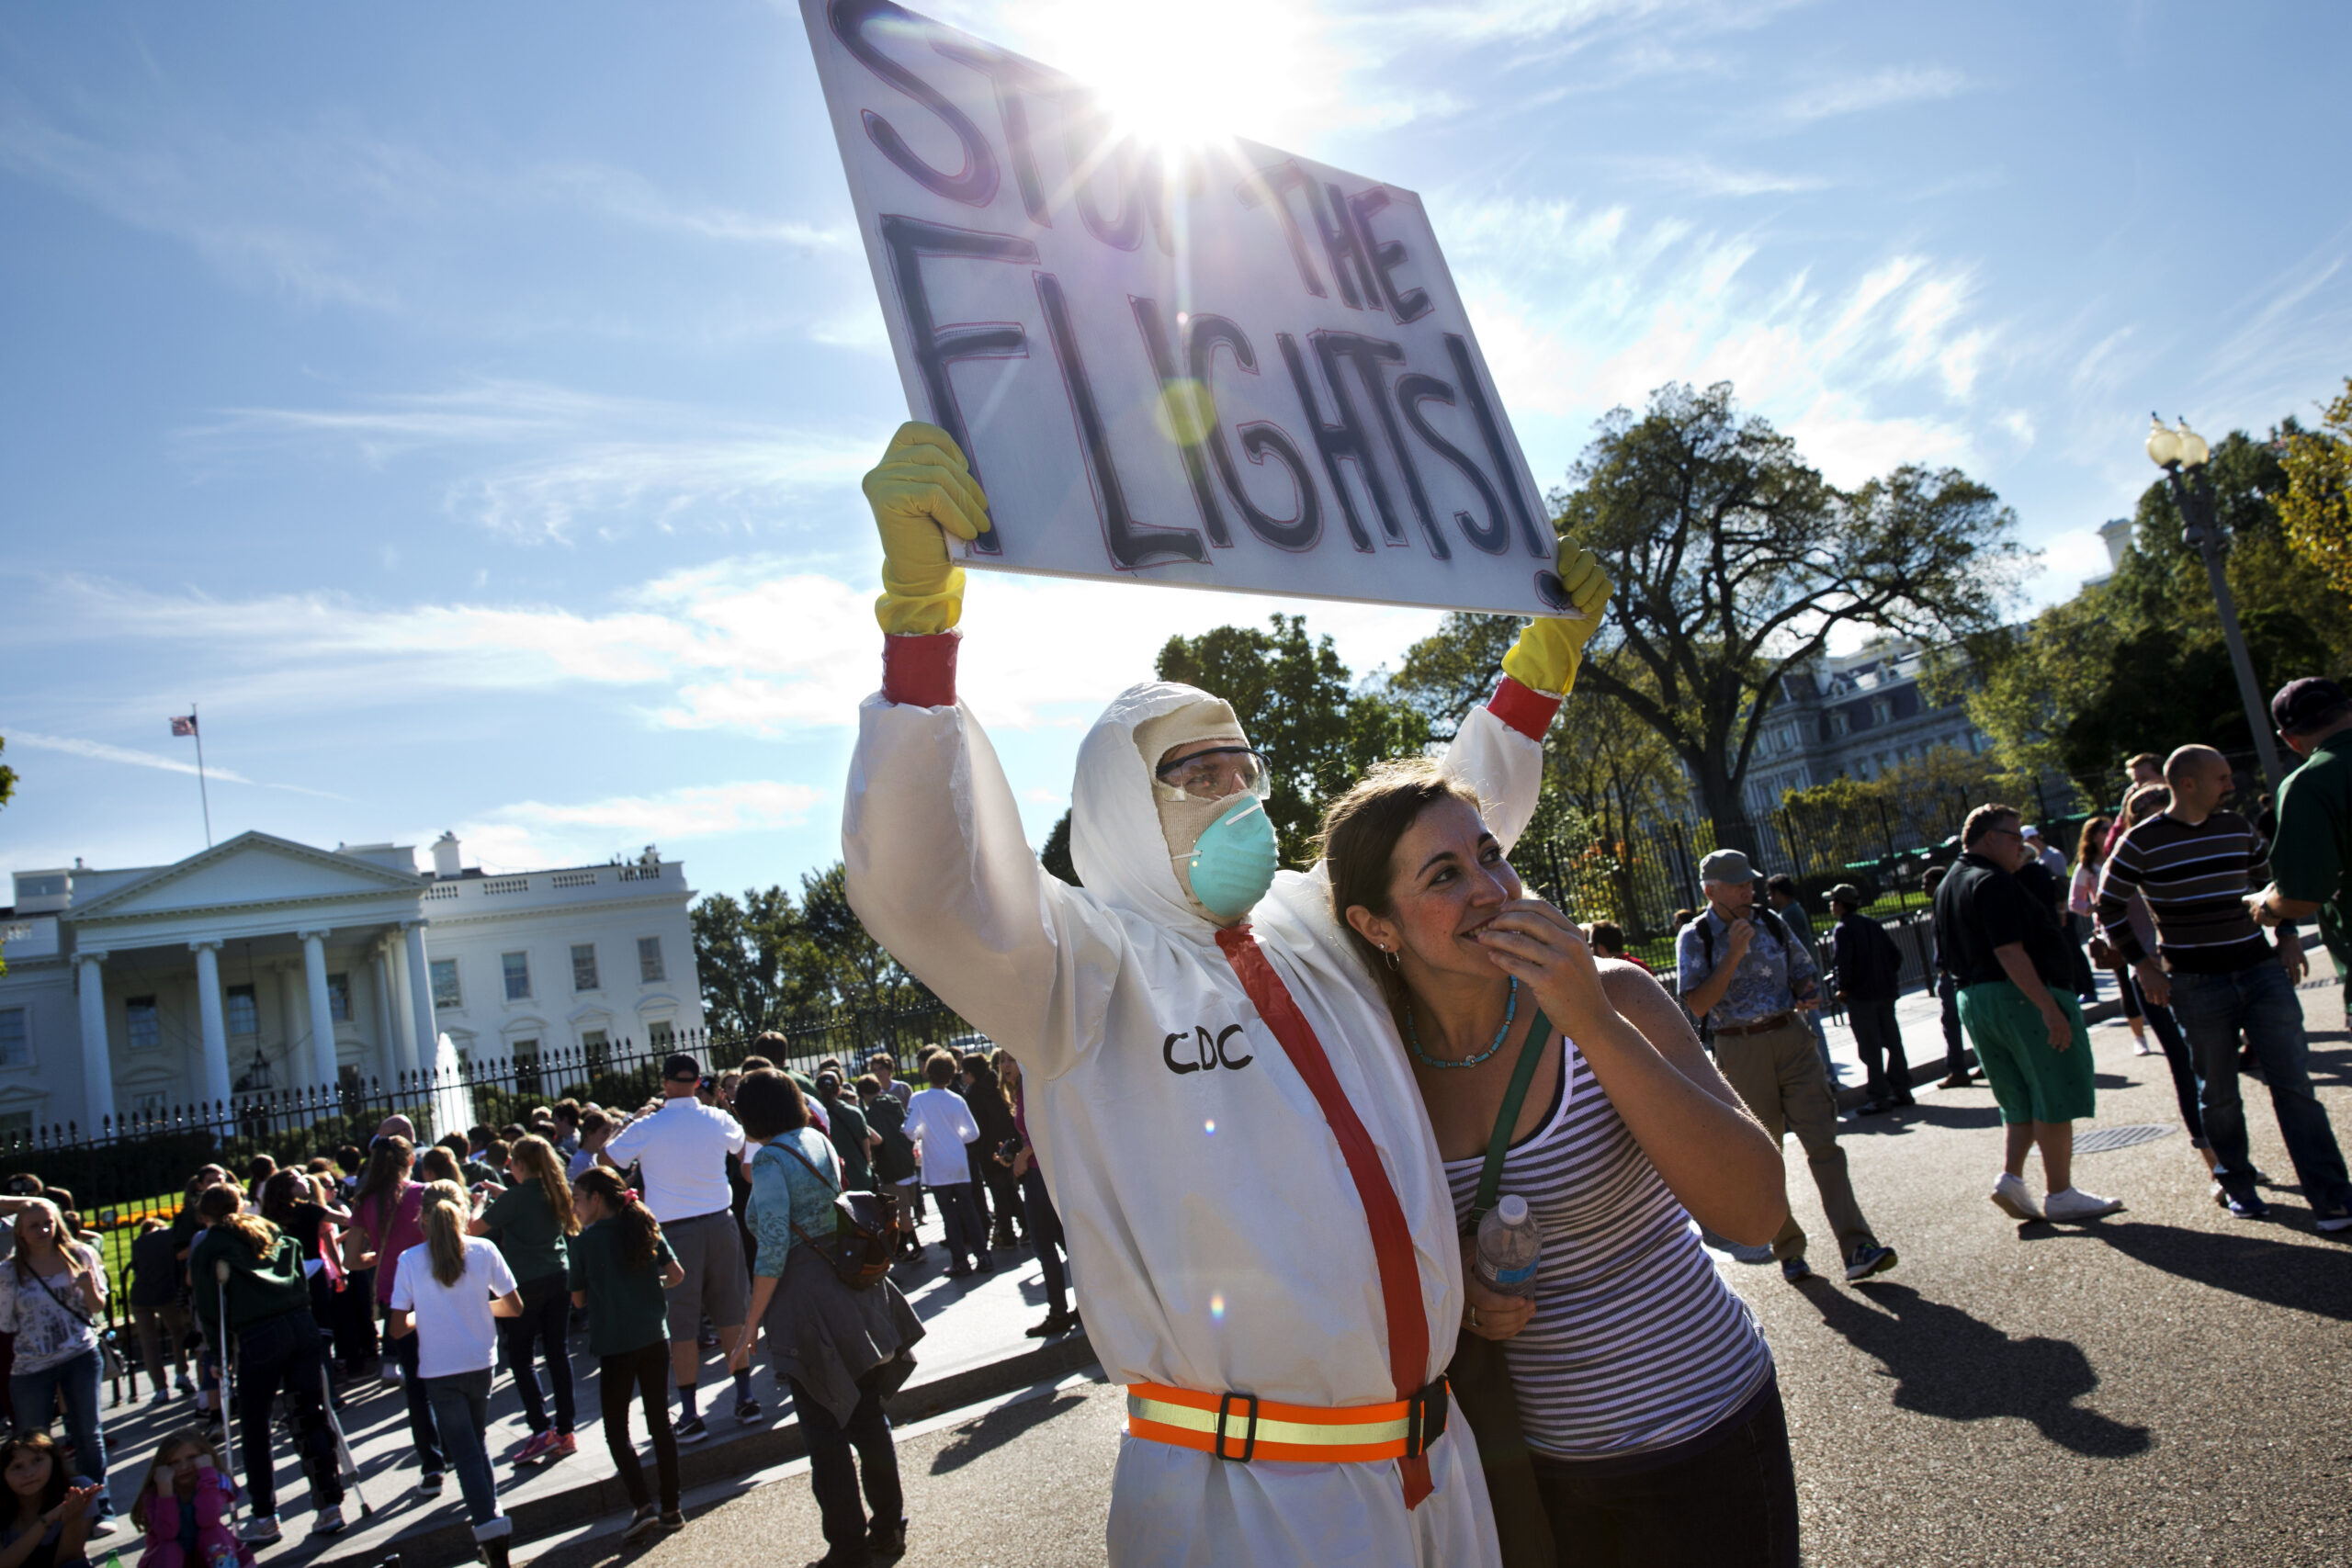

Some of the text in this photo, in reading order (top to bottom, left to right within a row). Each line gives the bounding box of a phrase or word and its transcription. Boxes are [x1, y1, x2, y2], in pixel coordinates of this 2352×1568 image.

[1234, 158, 1435, 325] THE
[879, 212, 1572, 612] FLIGHTS!
[1162, 1023, 1254, 1075] CDC
